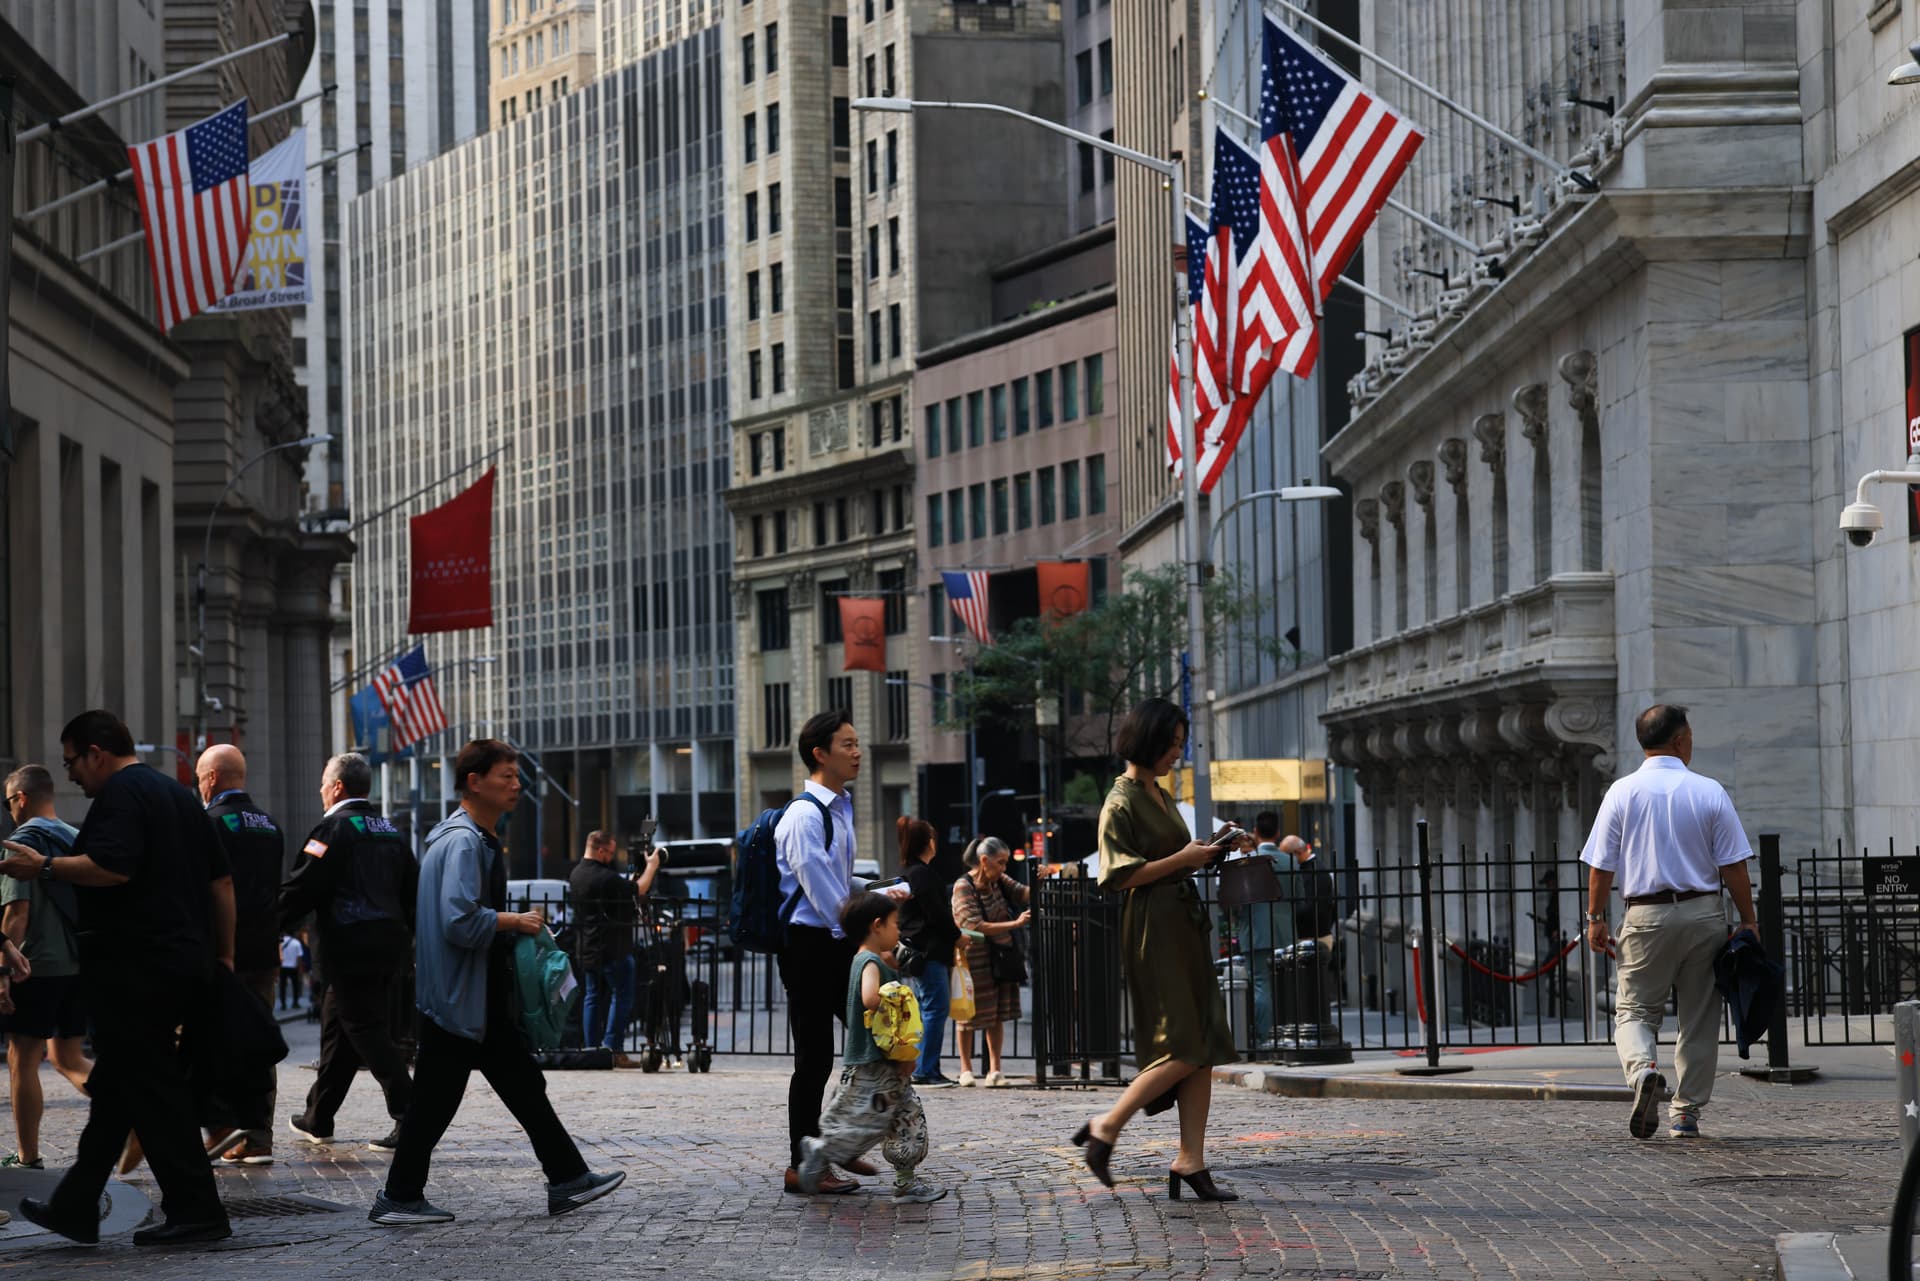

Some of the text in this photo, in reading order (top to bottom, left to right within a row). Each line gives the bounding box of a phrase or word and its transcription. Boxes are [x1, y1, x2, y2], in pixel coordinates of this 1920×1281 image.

[269, 290, 305, 304] Street
[1884, 874, 1900, 884] NO
[1876, 883, 1909, 893] ENTRY
